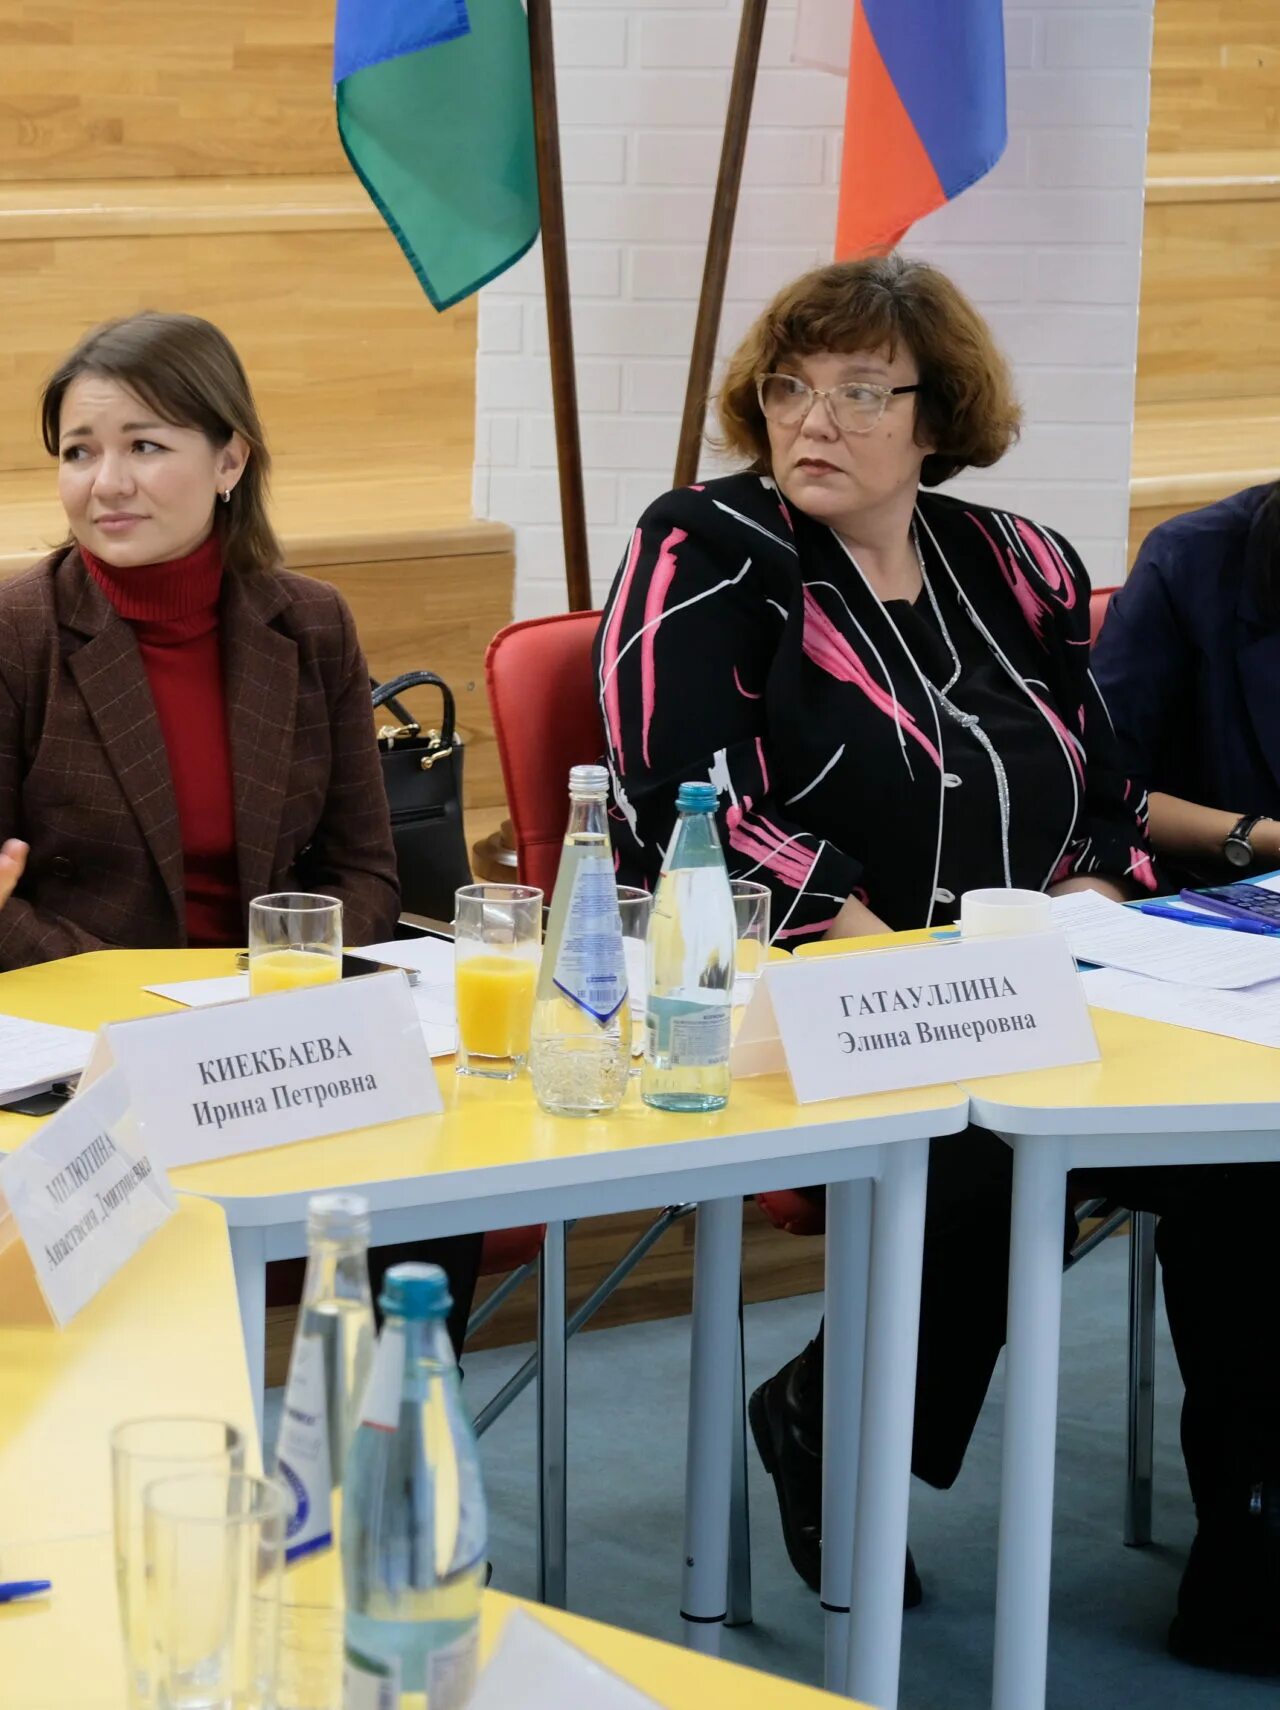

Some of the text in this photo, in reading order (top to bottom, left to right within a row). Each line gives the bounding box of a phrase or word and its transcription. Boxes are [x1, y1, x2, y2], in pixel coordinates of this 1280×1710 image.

[839, 976, 1018, 1018] ГАТАУЛЛИНА
[837, 1012, 1038, 1054] Элина Винеровна
[197, 1035, 353, 1086] КИЕКБАЕВА
[192, 1073, 378, 1129] Ирина Петровна
